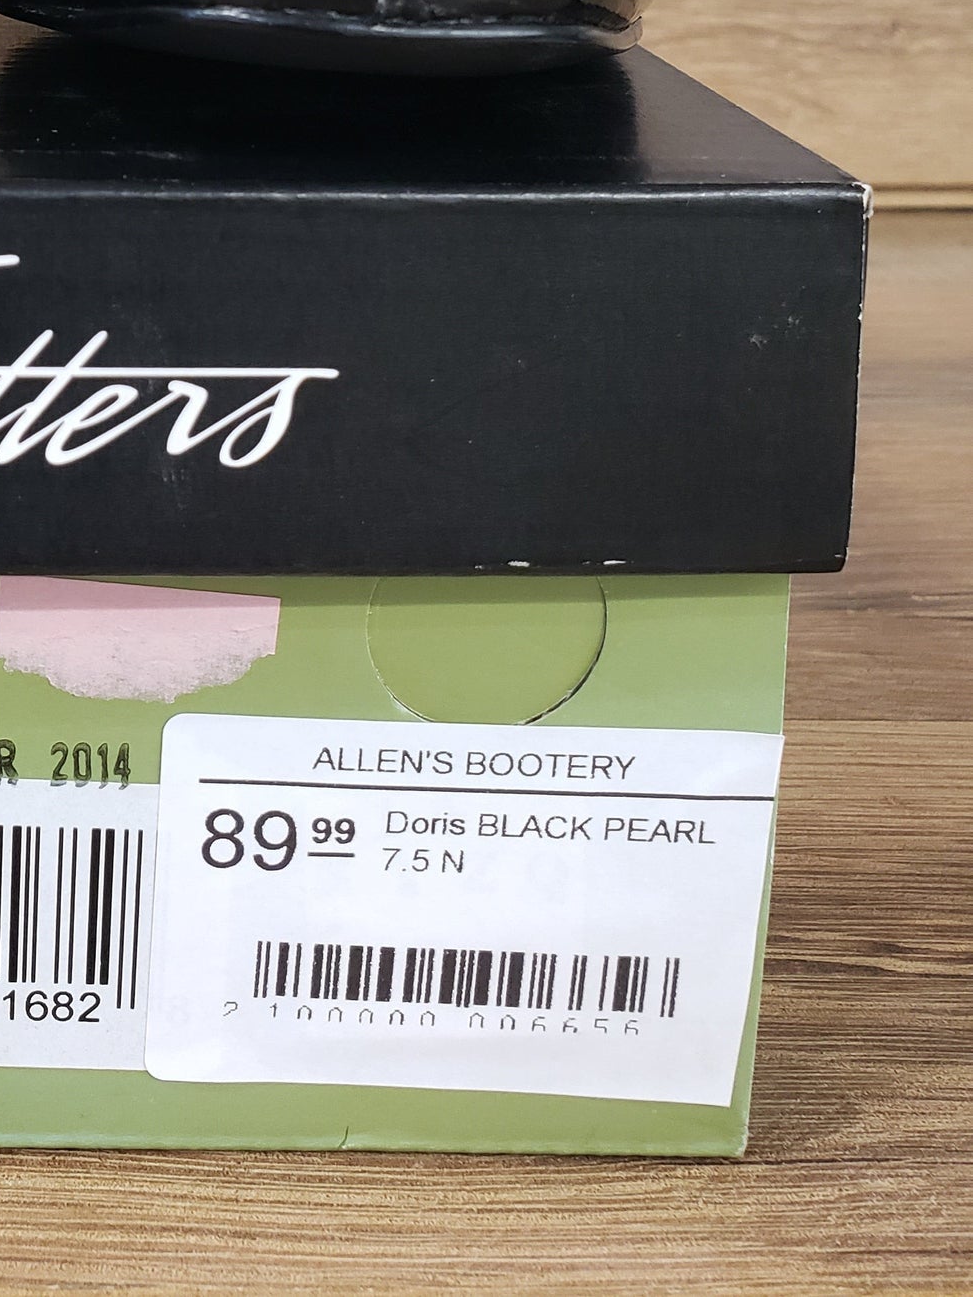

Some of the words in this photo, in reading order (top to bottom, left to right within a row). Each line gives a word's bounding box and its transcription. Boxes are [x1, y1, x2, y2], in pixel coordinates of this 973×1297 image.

[49, 741, 132, 789] 2014
[312, 746, 454, 776] ALLEN'S
[465, 750, 637, 781] BOOTERY
[385, 810, 467, 837] Doris
[477, 813, 593, 841] BLACK
[603, 817, 716, 845] PEARL
[382, 847, 430, 873] 7.5
[440, 849, 465, 873] N
